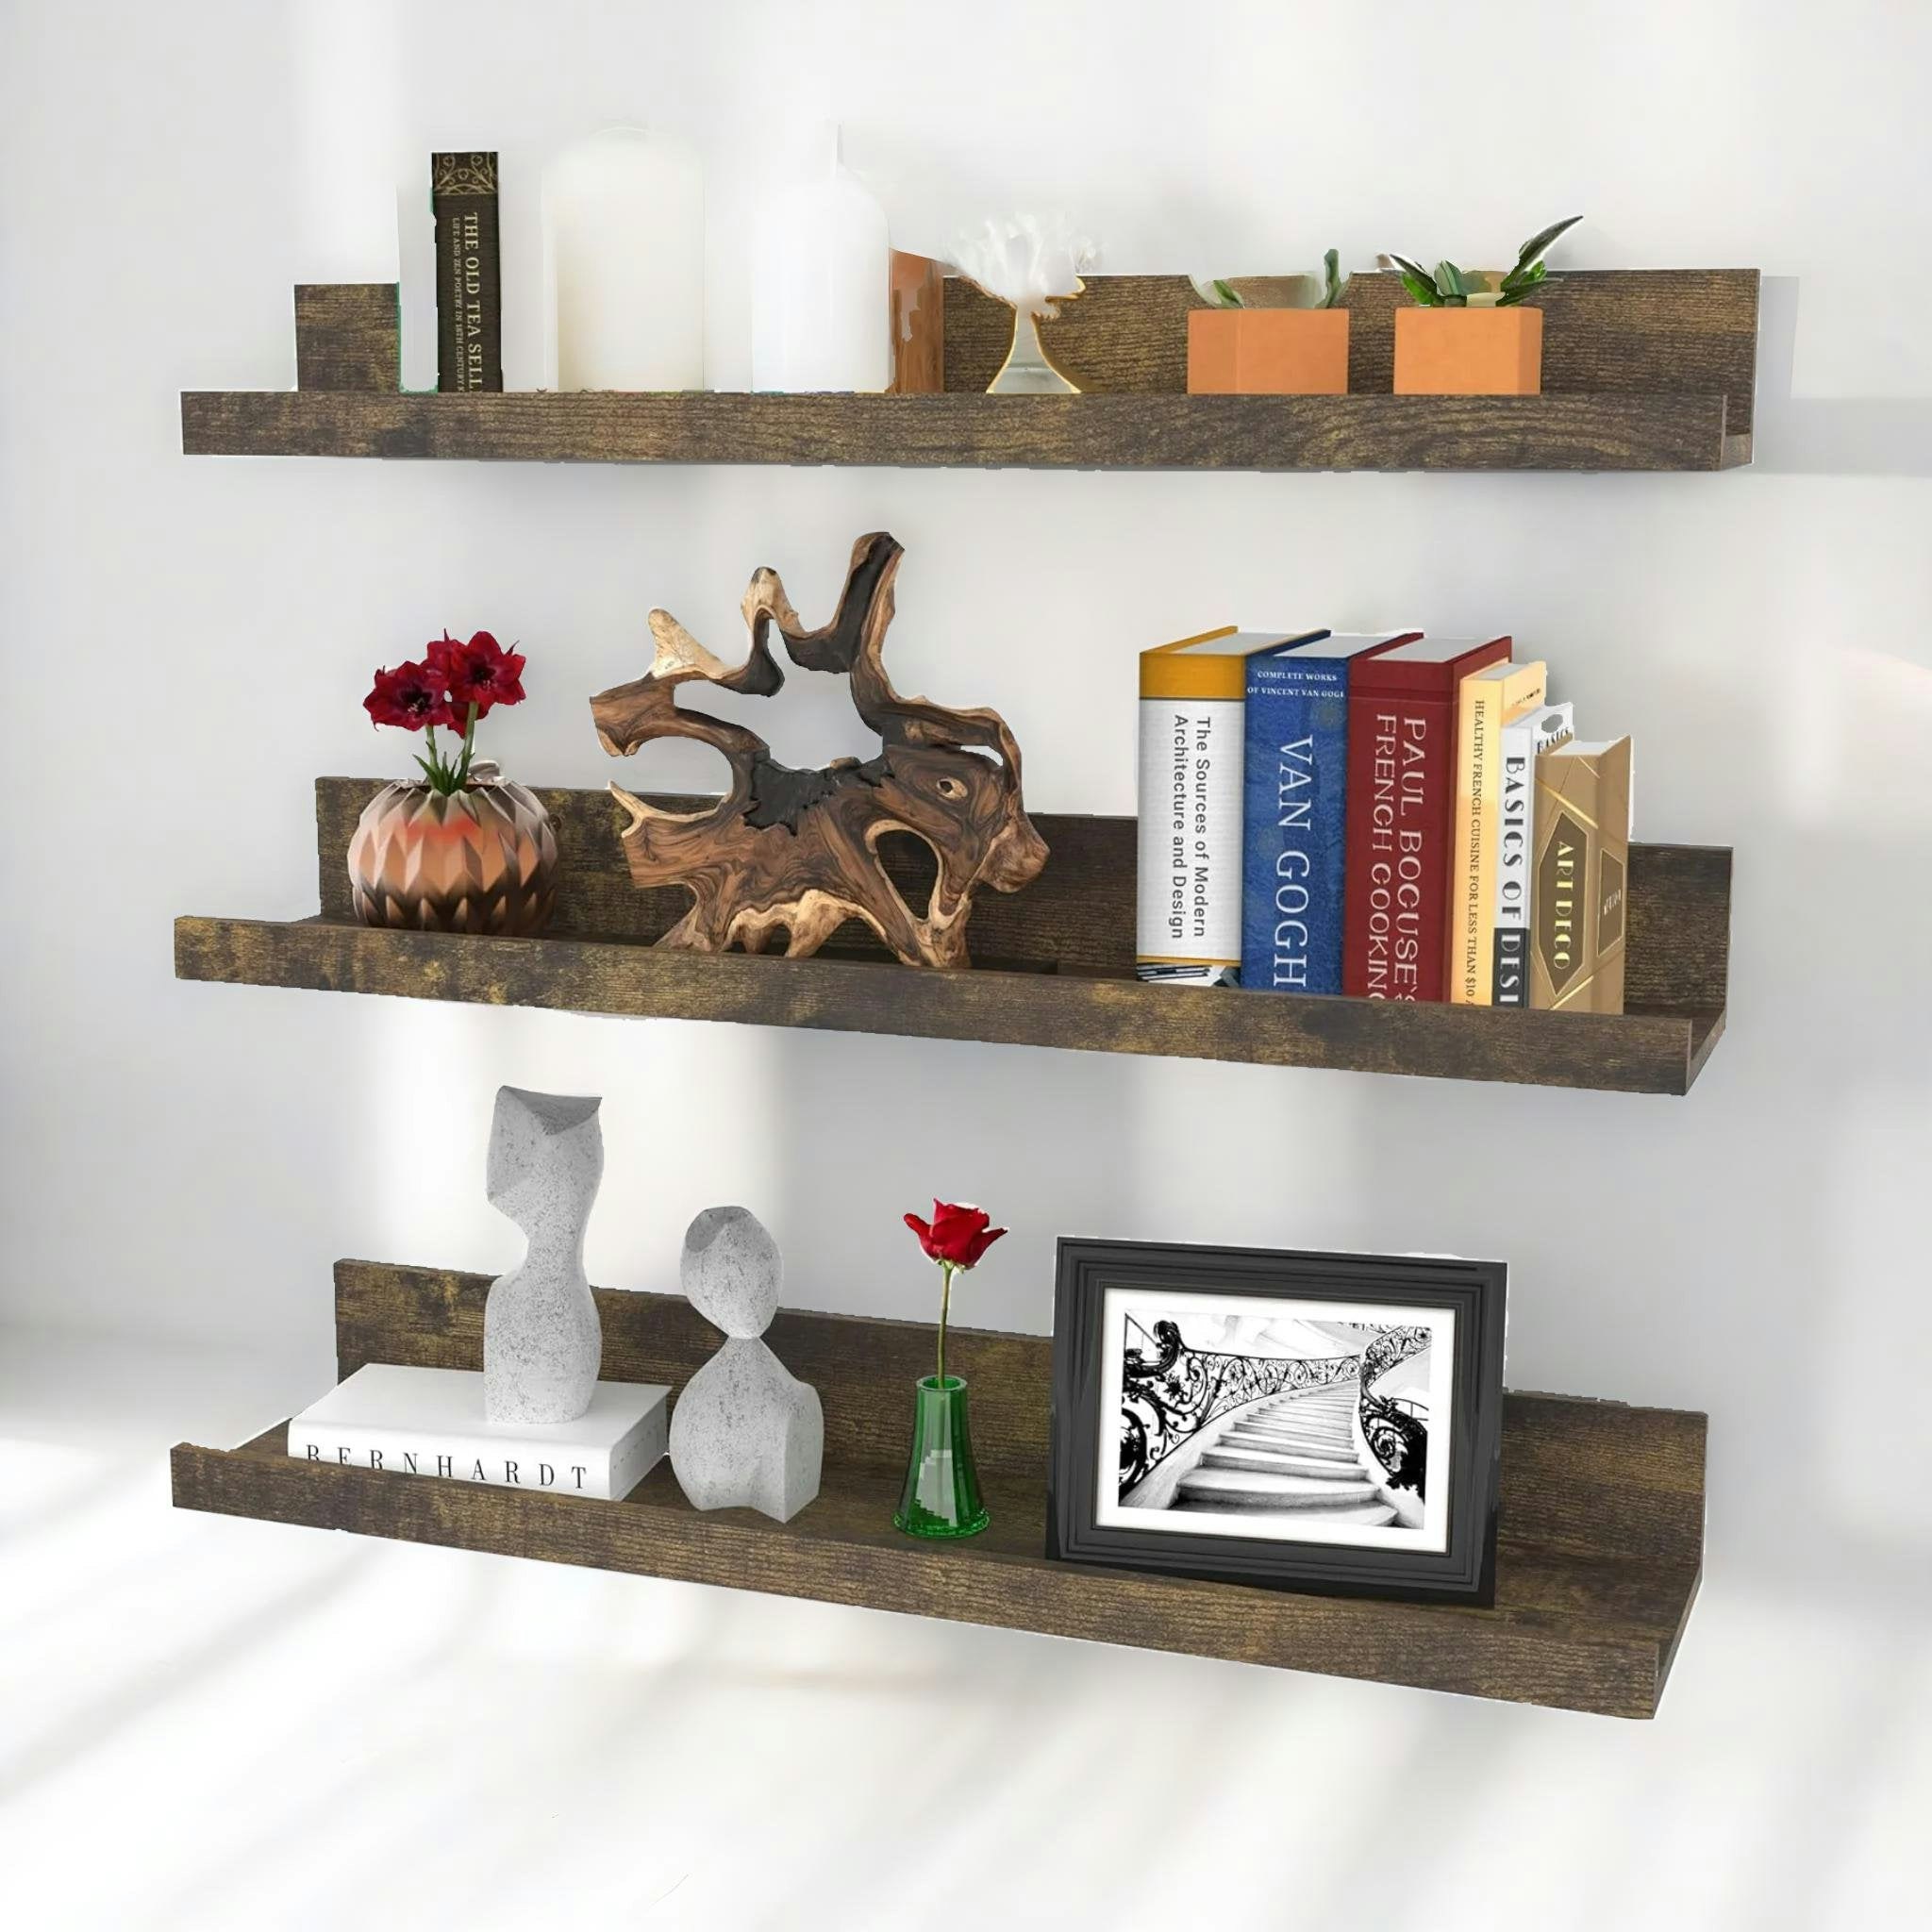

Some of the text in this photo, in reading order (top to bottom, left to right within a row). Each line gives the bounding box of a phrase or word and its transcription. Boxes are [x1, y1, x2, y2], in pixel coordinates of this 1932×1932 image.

[464, 212, 483, 392] THE OLD TEA SELL
[456, 345, 465, 385] CENTURY
[1247, 686, 1258, 694] OF
[1260, 688, 1299, 696] VINCENT
[1301, 689, 1319, 697] VAN
[1257, 671, 1303, 680] COMPLETE
[1474, 700, 1485, 761] HEALTHY
[1372, 714, 1396, 852] FRENCH
[1400, 718, 1426, 816] PAUL
[1472, 763, 1482, 816] FRENCH
[1169, 714, 1189, 939] Architecture and Design
[1193, 717, 1211, 937] The Sources of Modern
[1470, 819, 1481, 872] CUISINE
[1274, 734, 1314, 988] VAN GOGH
[1468, 875, 1479, 901] FOR
[1499, 757, 1525, 1002] BASICS OF DESI
[1467, 903, 1478, 935] LESS
[1553, 841, 1574, 970] ART DECO
[1466, 937, 1477, 974] THAN
[1465, 975, 1476, 997] $10
